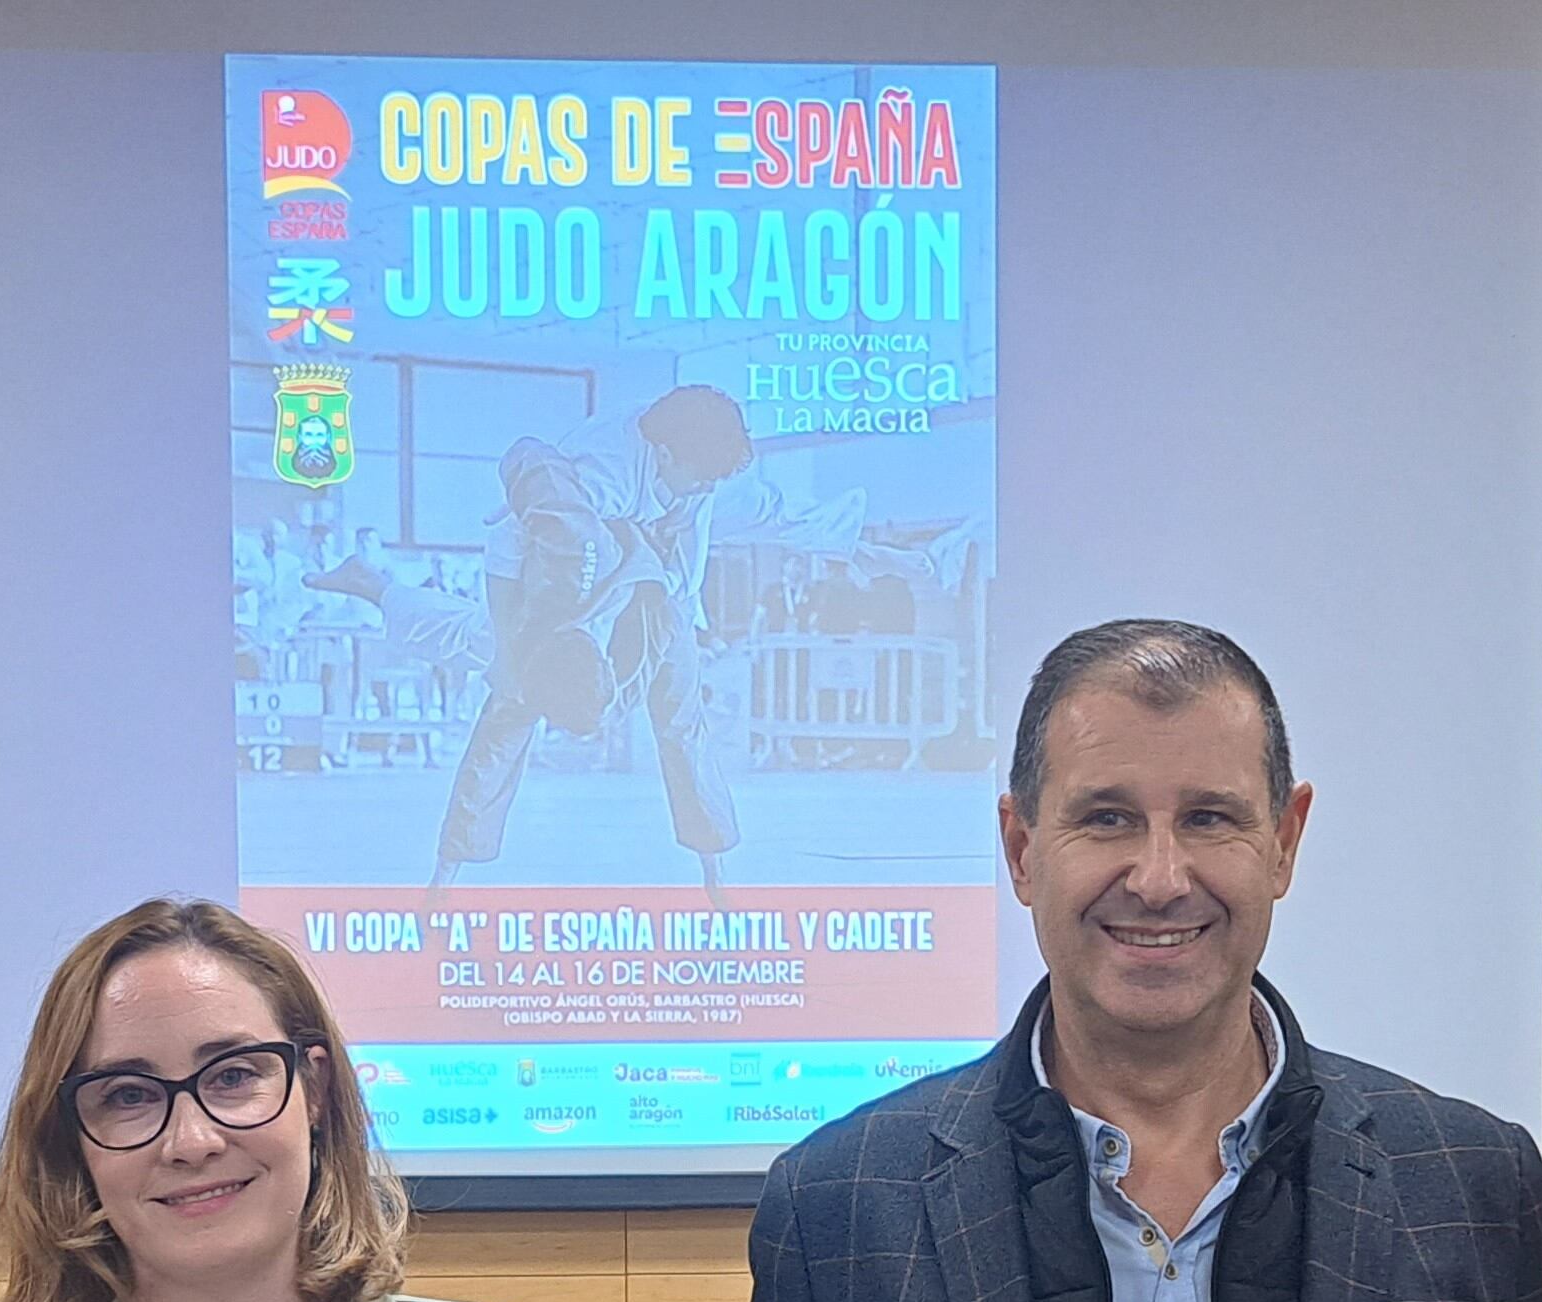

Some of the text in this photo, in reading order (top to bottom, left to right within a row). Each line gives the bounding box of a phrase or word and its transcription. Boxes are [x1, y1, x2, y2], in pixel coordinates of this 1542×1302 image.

[379, 87, 962, 189] COPAS DE ESPAÑA
[266, 145, 337, 169] JUDO
[384, 193, 960, 322] JUDO ARAGÓN
[775, 333, 929, 352] TU PROVINCIA
[746, 356, 962, 403] Huesca
[249, 746, 282, 770] 12
[305, 912, 335, 952] VI
[346, 912, 421, 952] COPA
[499, 912, 534, 952] DE
[544, 906, 654, 952] ESPAÑA
[664, 911, 790, 951] INFANTIL
[797, 911, 819, 951] Y
[826, 911, 933, 951] CADETE
[440, 959, 804, 986] DEL 14 AL 16 DE NOVIEMBRE
[440, 992, 804, 1010] POLIDEPORTIVO ÁNGEL ORÚS, BARBASTRO (HUESCA)
[503, 1010, 743, 1026] (OBISPO ABAD Y LA SIERRA, 1987)
[615, 1062, 668, 1082] Jaca
[630, 1095, 658, 1107] alto
[423, 1107, 481, 1125] asisa
[524, 1105, 597, 1121] amazon
[629, 1105, 683, 1122] aragón
